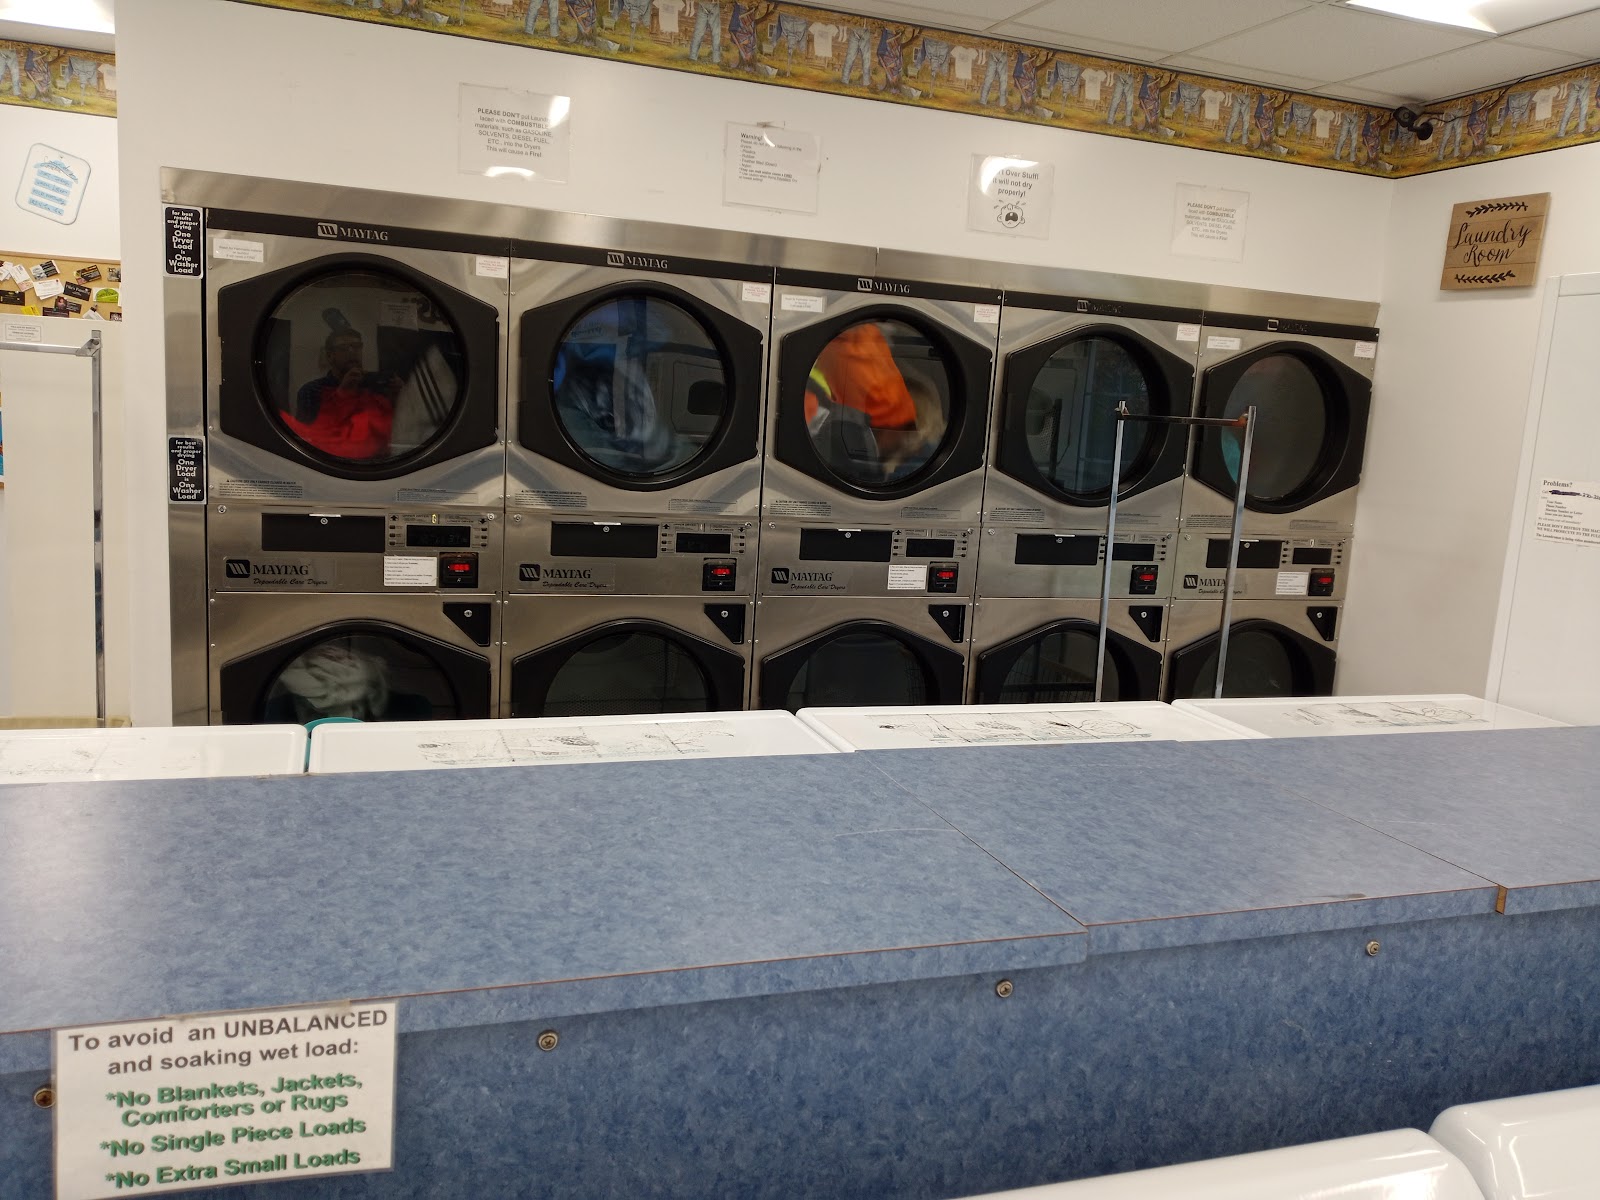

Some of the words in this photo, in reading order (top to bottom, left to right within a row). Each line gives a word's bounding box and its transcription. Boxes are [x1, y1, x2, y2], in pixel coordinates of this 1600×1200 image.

[478, 108, 501, 116] PLEASE
[474, 122, 500, 131] materials,
[507, 119, 550, 130] COMBUSTIBLE
[512, 134, 532, 142] DIESEL
[741, 132, 762, 141] Warning!
[524, 143, 541, 151] Dryers
[1006, 169, 1020, 178] Over
[1022, 172, 1039, 180] Stuff!
[1022, 182, 1032, 190] dry
[998, 188, 1026, 198] properly!
[340, 227, 388, 241] MAYTAG
[1453, 220, 1532, 250] Laundry
[172, 236, 194, 244] Dryer
[173, 242, 193, 250] Load
[1463, 244, 1515, 267] Room
[169, 260, 198, 268] Washer
[626, 256, 668, 269] MAYTAG
[174, 266, 193, 274] Load
[874, 281, 911, 293] MAYTAG
[253, 564, 309, 575] MAYTAG
[543, 569, 591, 579] MAYTAG
[791, 572, 832, 581] MAYTAG
[307, 578, 328, 586] Dryers
[68, 1034, 100, 1051] To
[108, 1027, 174, 1048] avoid
[188, 1025, 216, 1042] an
[224, 1009, 388, 1038] UNBALANCED
[108, 1055, 152, 1076] and
[160, 1047, 252, 1069] soaking
[259, 1046, 298, 1061] wet
[305, 1038, 358, 1057] load:
[157, 1078, 265, 1104] Blankets,
[271, 1071, 363, 1094] Jackets,
[121, 1098, 254, 1127] Comforters
[260, 1098, 285, 1114] or
[291, 1092, 349, 1113] Rugs
[151, 1129, 225, 1153] Single
[232, 1124, 293, 1144] Piece
[300, 1117, 367, 1138] Loads
[156, 1164, 217, 1184] Extra
[224, 1155, 287, 1176] Small
[293, 1149, 361, 1170] Loads
